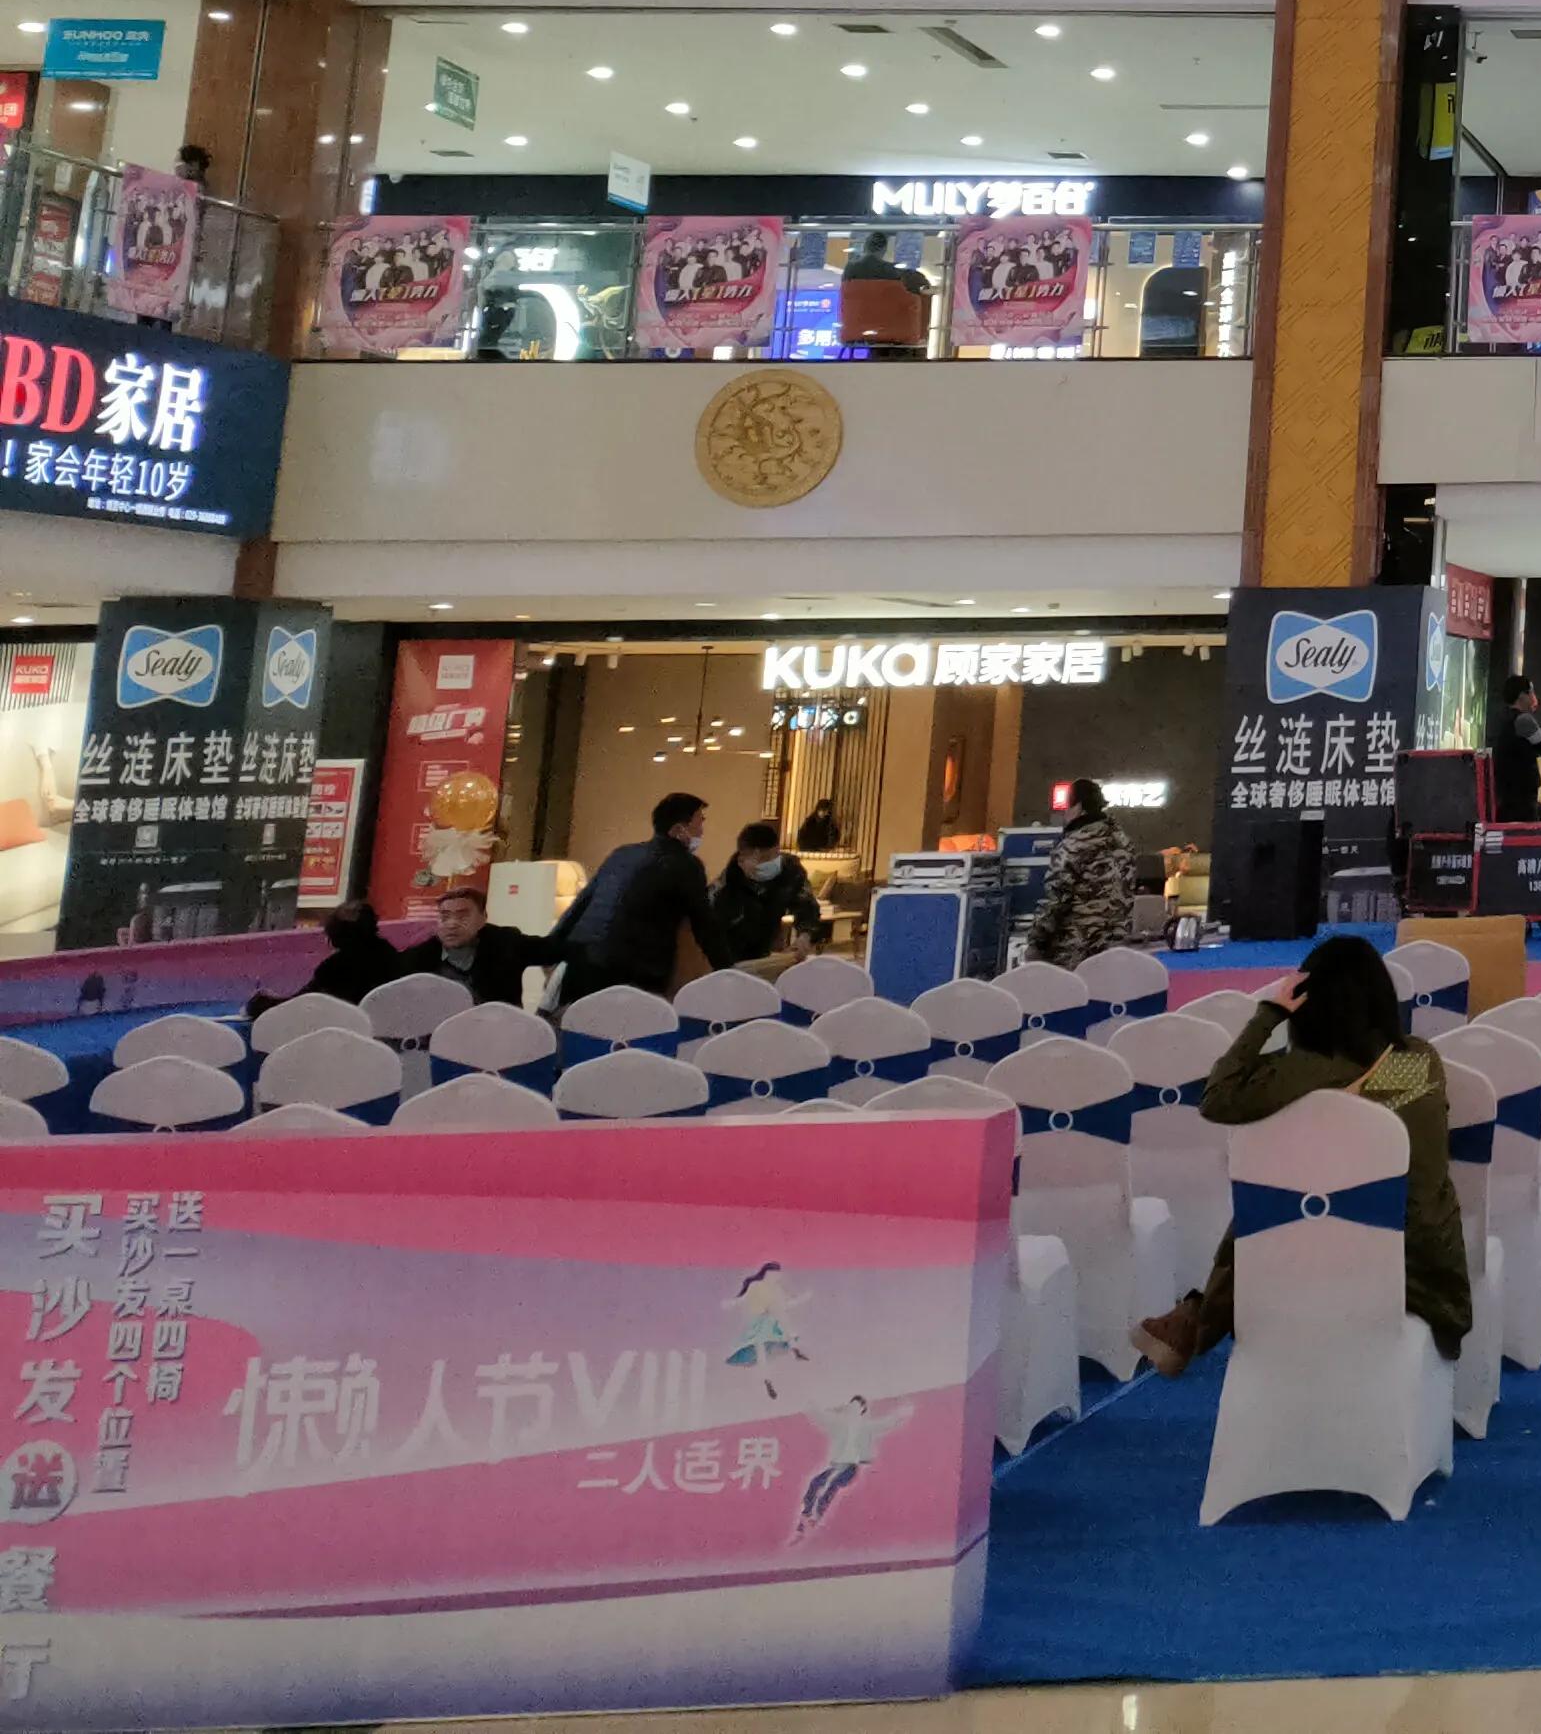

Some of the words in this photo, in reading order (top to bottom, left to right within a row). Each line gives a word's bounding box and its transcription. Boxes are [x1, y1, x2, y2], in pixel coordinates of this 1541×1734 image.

[134, 648, 202, 681] Sealy
[272, 648, 303, 683] Sealy
[934, 642, 1106, 685] 顾家家居
[1283, 637, 1357, 675] Sealy
[78, 729, 232, 786] 丝涟床垫
[238, 730, 316, 785] 丝涟床垫
[1229, 712, 1401, 776] 丝涟床垫
[74, 796, 229, 826] 全球奢侈睡眠体验馆
[1229, 778, 1397, 809] 全球奢侈睡眠体验馆
[146, 1190, 207, 1406] 送一桌四椅
[90, 1193, 163, 1496] 买沙发四个位置
